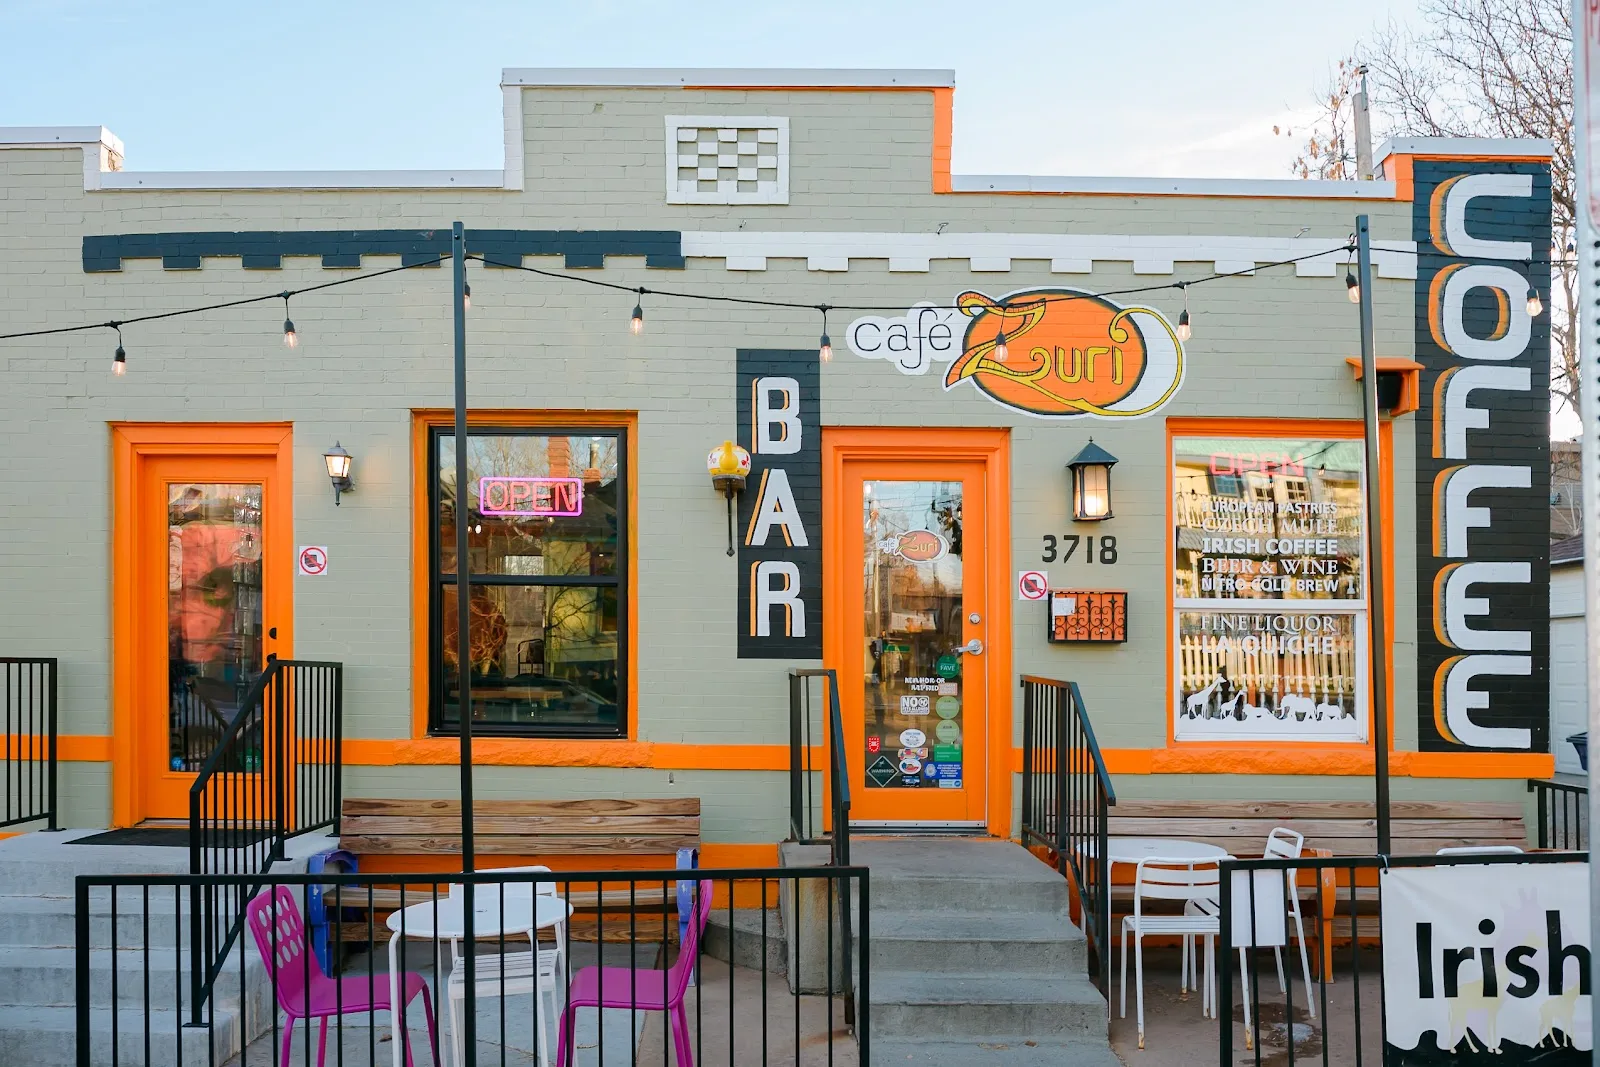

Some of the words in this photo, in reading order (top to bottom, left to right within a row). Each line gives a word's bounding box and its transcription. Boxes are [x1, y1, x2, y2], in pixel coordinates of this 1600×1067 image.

[854, 308, 953, 370] café
[946, 291, 1135, 396] Zuri
[1209, 452, 1305, 476] OPEN
[1429, 174, 1533, 749] COFFEE
[485, 481, 577, 512] OPEN
[745, 376, 809, 638] BAR
[1278, 502, 1337, 514] PASTRIES
[1280, 518, 1337, 534] MULE
[1041, 534, 1118, 565] 3718
[1202, 537, 1260, 554] IRISH
[1265, 538, 1338, 555] COFFEE
[1202, 558, 1255, 574] BEER
[1259, 559, 1275, 575] &
[1281, 559, 1338, 575] WINE
[1201, 577, 1244, 592] NITRO
[1251, 578, 1291, 592] COLD
[1296, 579, 1339, 592] BREW
[1200, 615, 1248, 631] FINE
[1255, 615, 1336, 635] LIQUOR
[1202, 635, 1233, 654] LA
[1241, 635, 1335, 656] QUICHE
[1416, 909, 1592, 998] Irish
